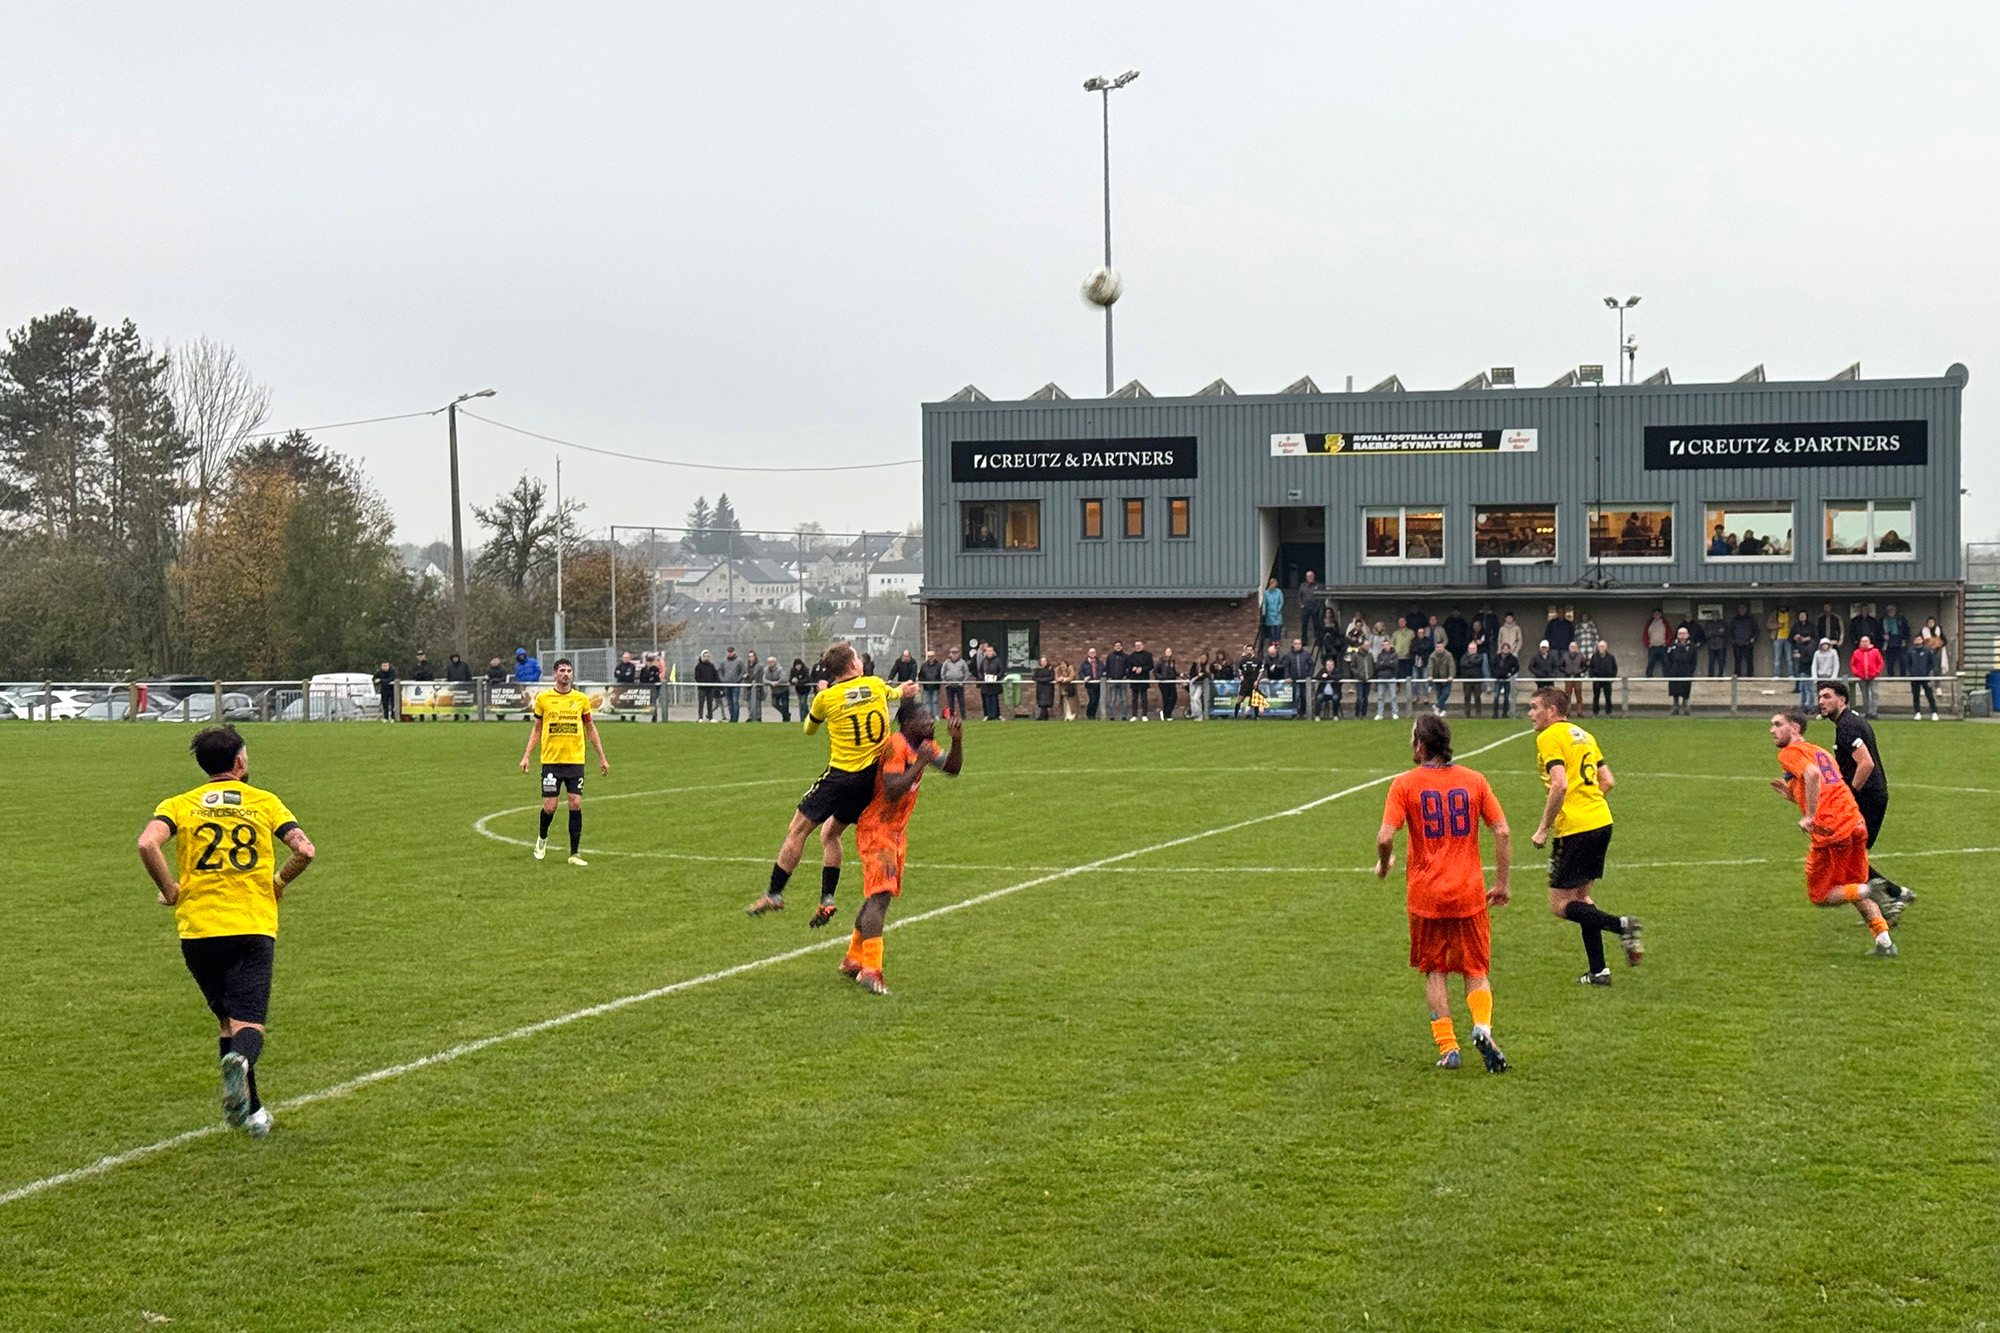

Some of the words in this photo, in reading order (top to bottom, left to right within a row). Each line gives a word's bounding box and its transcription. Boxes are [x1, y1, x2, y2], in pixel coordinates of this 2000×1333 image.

[1352, 433, 1384, 442] ROYAL
[1385, 432, 1436, 441] FOOTBALL
[1437, 432, 1463, 440] CLUB
[1688, 437, 1770, 455] CREUTZ
[1774, 438, 1792, 453] &
[1793, 434, 1900, 453] PARTNERS
[989, 452, 1061, 469] CREUTZ
[1065, 453, 1080, 468] &
[1082, 450, 1174, 468] PARTNERS
[847, 710, 885, 746] 10
[1580, 751, 1596, 786] 6
[1815, 752, 1838, 784] 8
[1420, 788, 1471, 838] 98
[194, 822, 259, 870] 28
